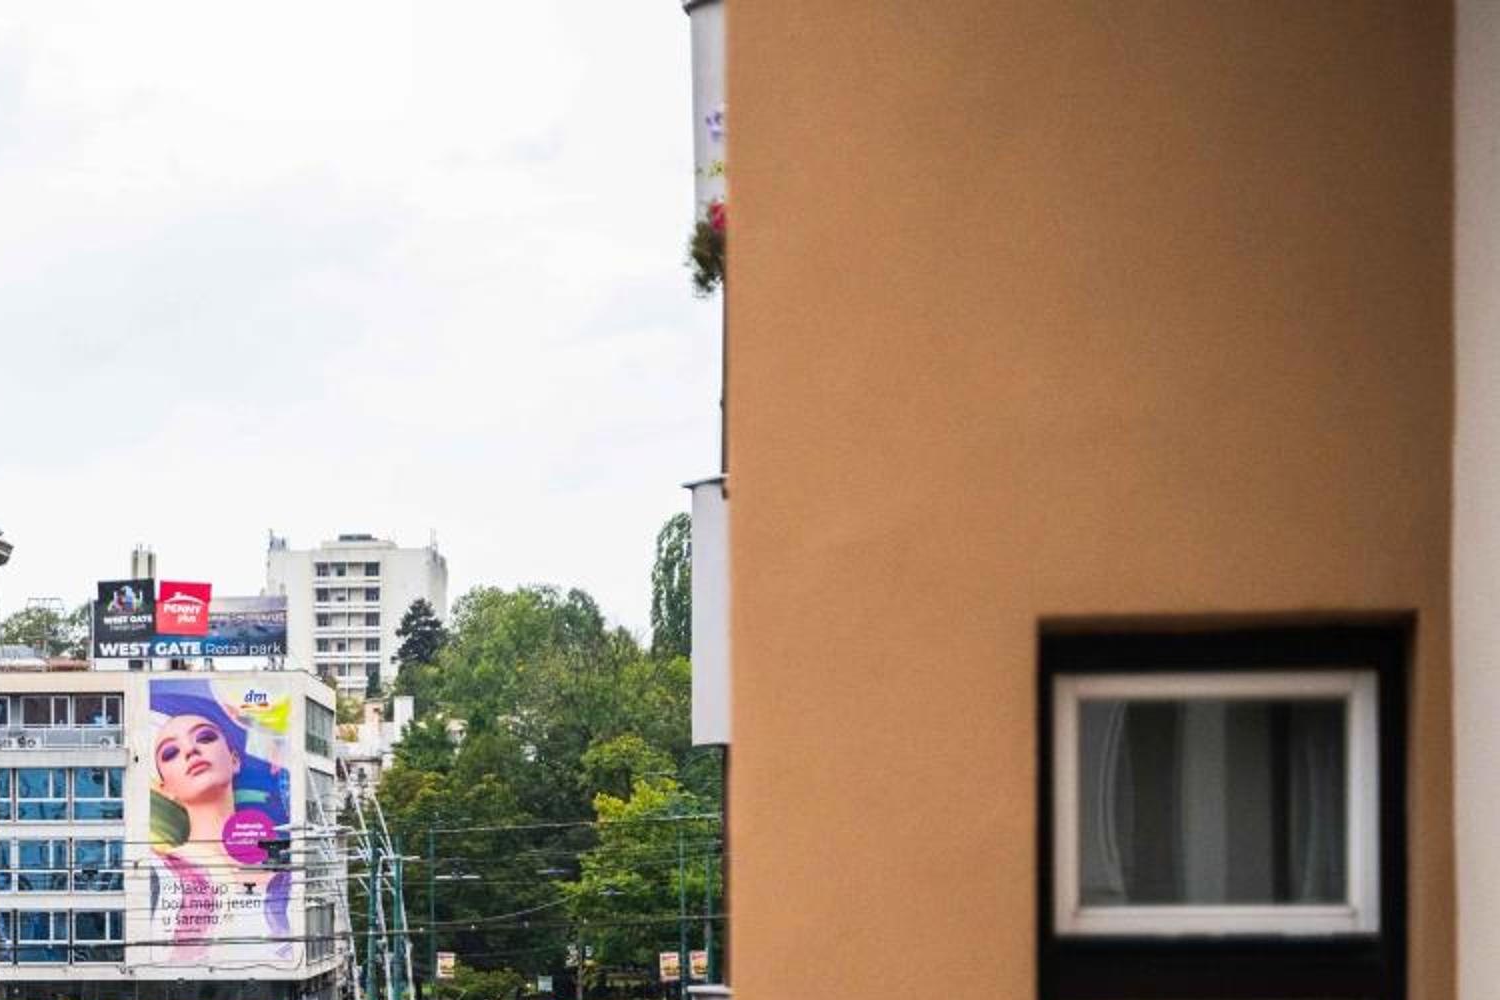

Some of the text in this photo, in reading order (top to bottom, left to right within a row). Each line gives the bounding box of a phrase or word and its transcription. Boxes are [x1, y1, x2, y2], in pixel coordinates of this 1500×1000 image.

[163, 603, 201, 614] PENNY
[103, 613, 153, 625] WEST GATE
[100, 641, 281, 656] WEST GATE Retail park
[244, 689, 267, 703] dm
